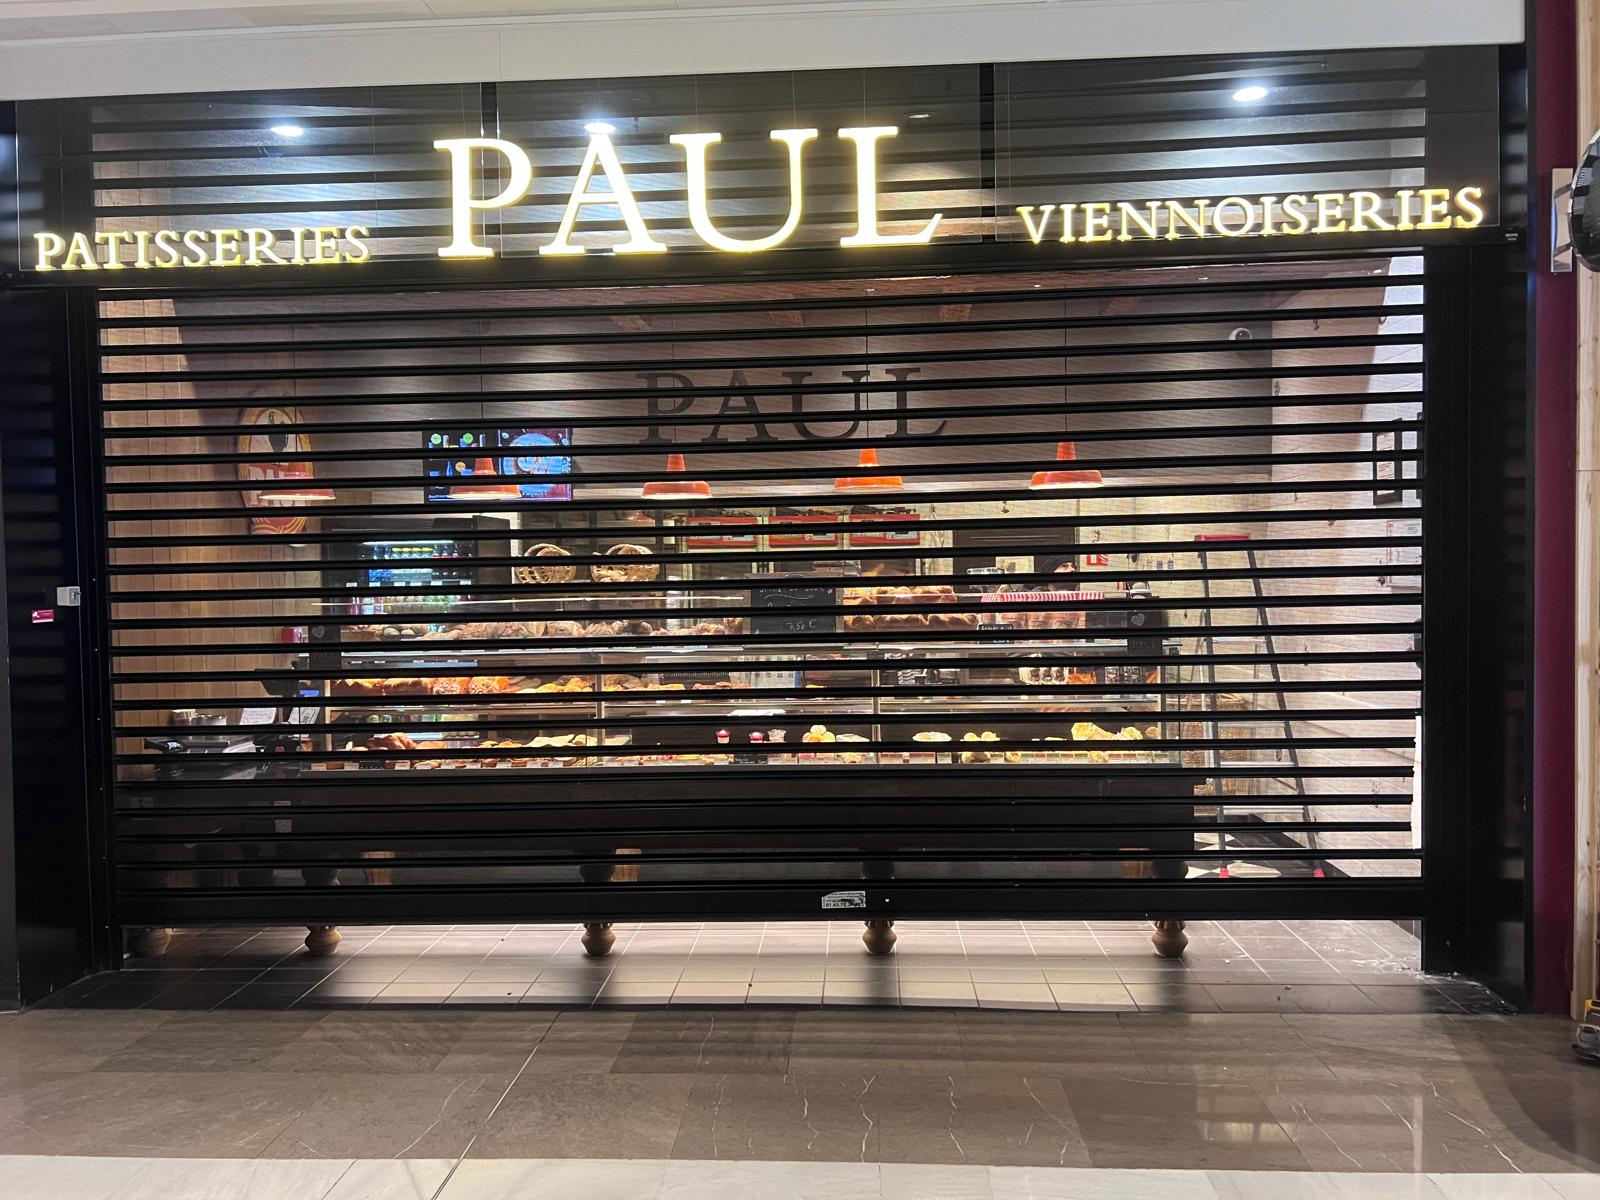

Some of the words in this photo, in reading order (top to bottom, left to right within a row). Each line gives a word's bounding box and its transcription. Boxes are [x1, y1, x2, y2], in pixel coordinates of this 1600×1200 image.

[433, 126, 943, 259] PAUL
[1015, 186, 1485, 245] VIENNOISERIES
[34, 225, 371, 272] PATISSERIES
[635, 367, 947, 444] PAUL
